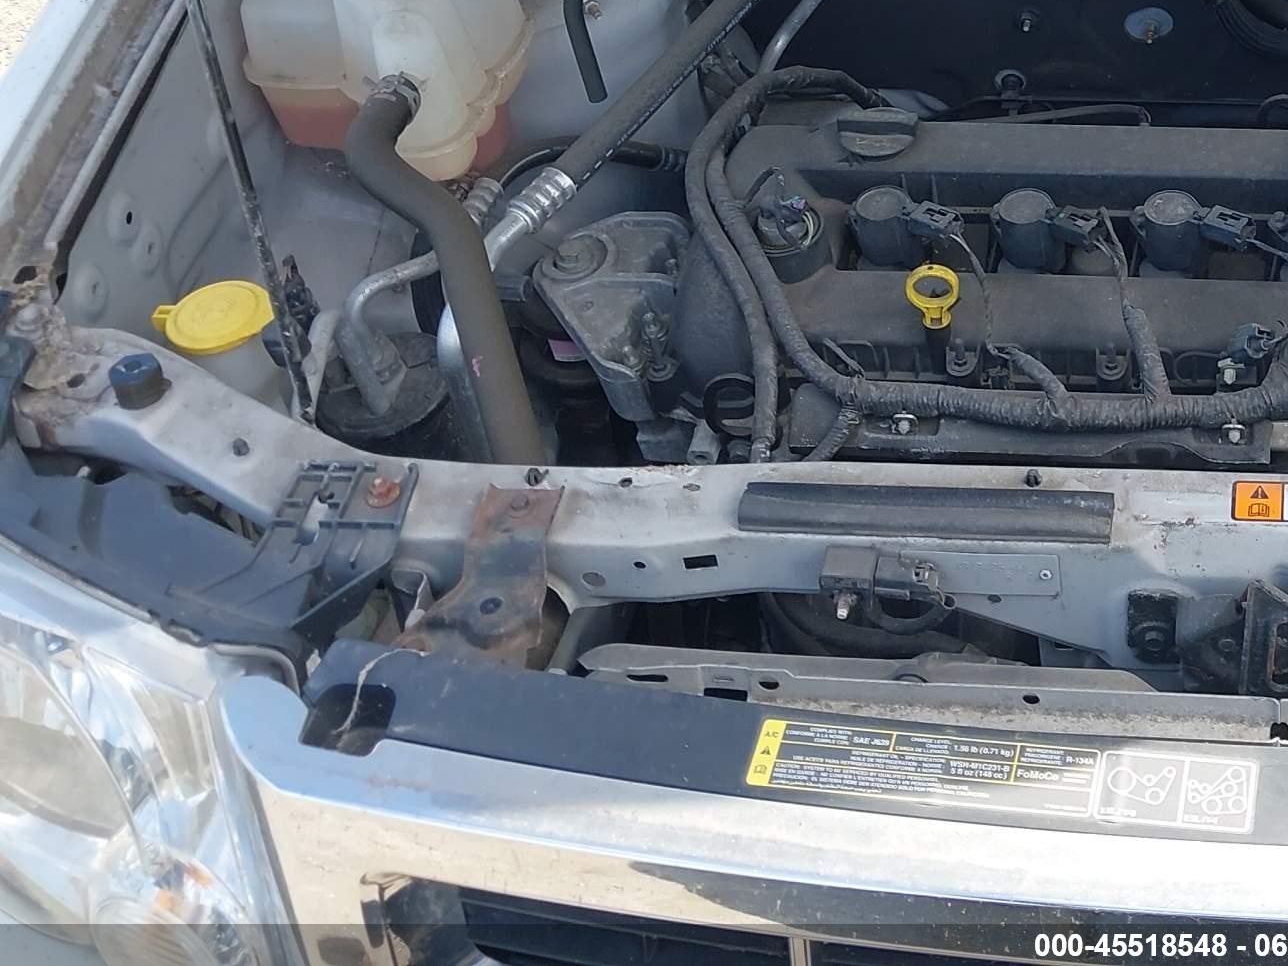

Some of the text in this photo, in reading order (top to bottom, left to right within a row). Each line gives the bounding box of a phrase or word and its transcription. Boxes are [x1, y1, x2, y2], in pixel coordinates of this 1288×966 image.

[852, 736, 870, 744] SAE
[1001, 748, 1013, 757] kg)
[1017, 768, 1058, 780] FoMoCo
